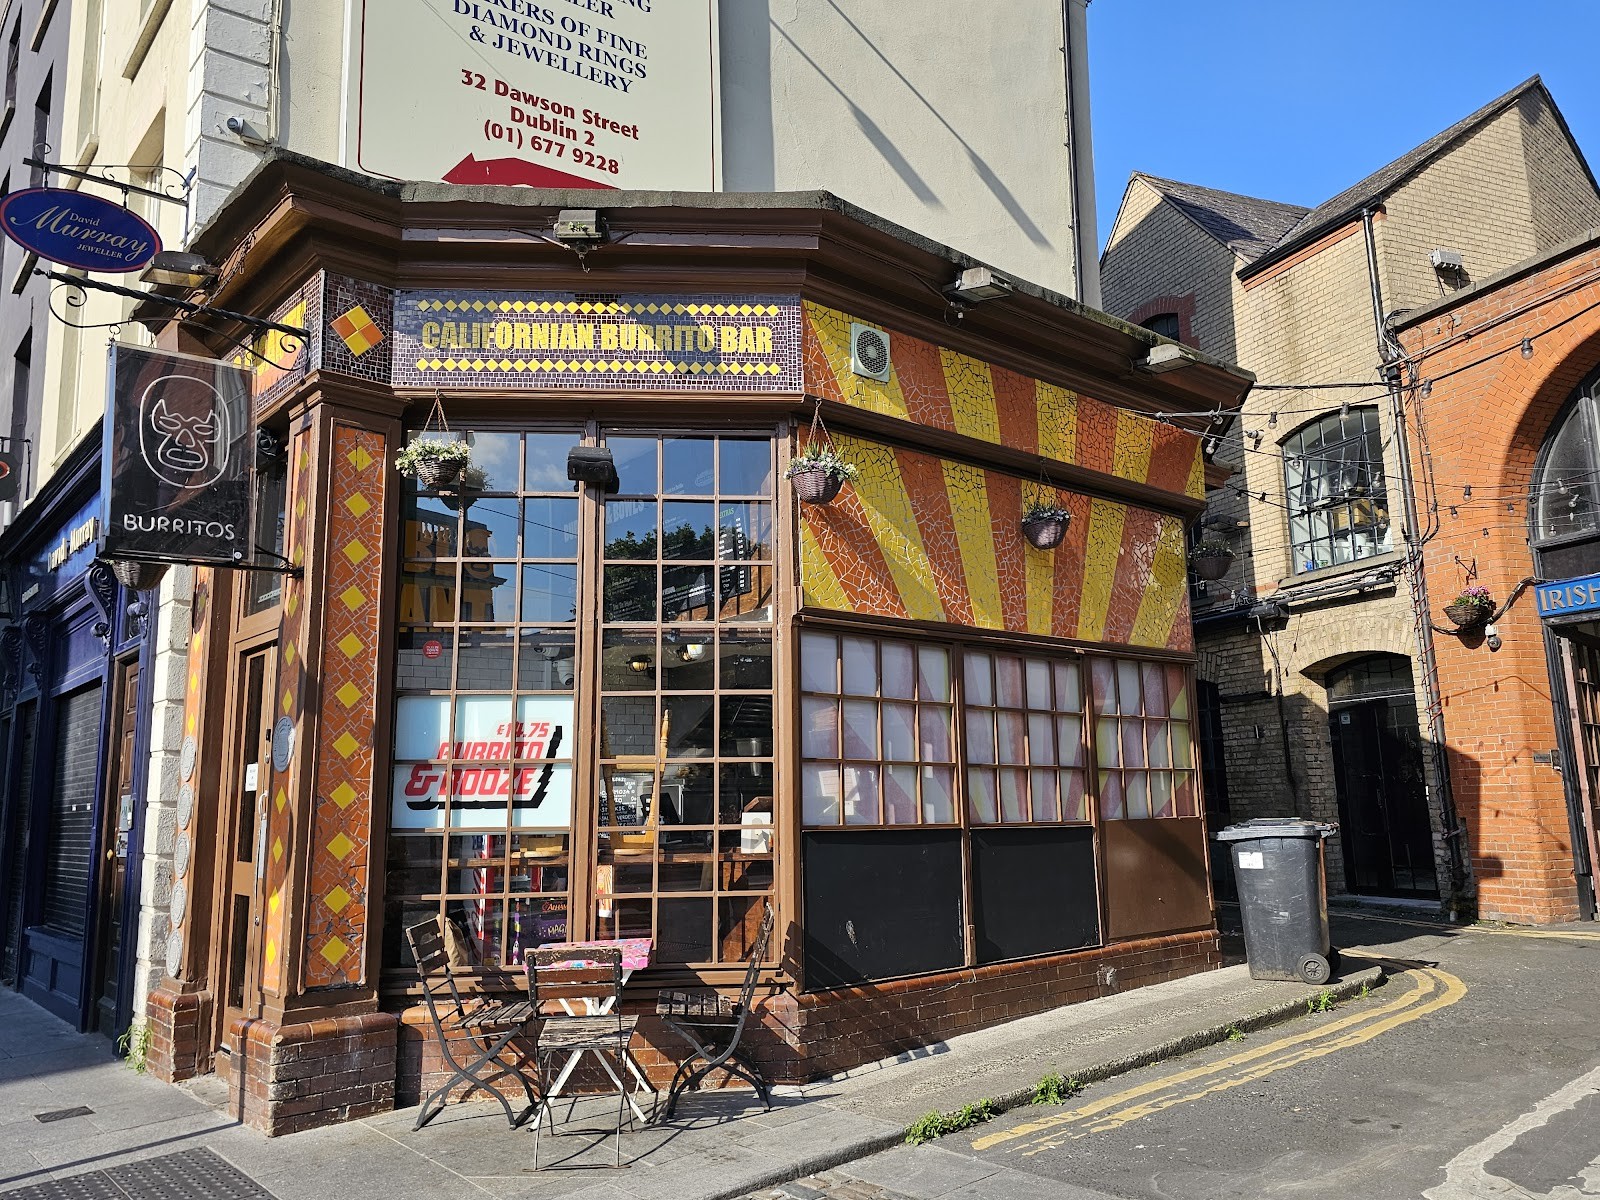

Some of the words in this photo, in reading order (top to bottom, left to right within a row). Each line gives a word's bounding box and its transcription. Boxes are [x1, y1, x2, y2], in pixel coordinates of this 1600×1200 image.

[453, 0, 572, 51] DIAMOND
[578, 41, 647, 79] RINGS
[469, 25, 487, 44] &
[492, 33, 633, 93] JEWELLERY
[560, 16, 590, 37] OF
[595, 28, 648, 60] FINE
[461, 69, 487, 91] 32
[494, 79, 575, 119] Dawson
[582, 108, 639, 140] Street
[484, 119, 523, 149] (01)
[530, 135, 566, 158] 677
[572, 148, 619, 174] 9228
[510, 106, 577, 141] Dublin
[584, 130, 595, 147] 2
[9, 205, 148, 262] Murray
[69, 212, 100, 227] David
[77, 243, 122, 259] JEWELLER
[421, 320, 594, 351] CALIFORNIAN
[599, 323, 718, 353] BURRITO
[720, 325, 773, 354] BAR
[123, 513, 235, 541] BURRITOS
[404, 763, 439, 796] &
[438, 767, 538, 796] BOOZE
